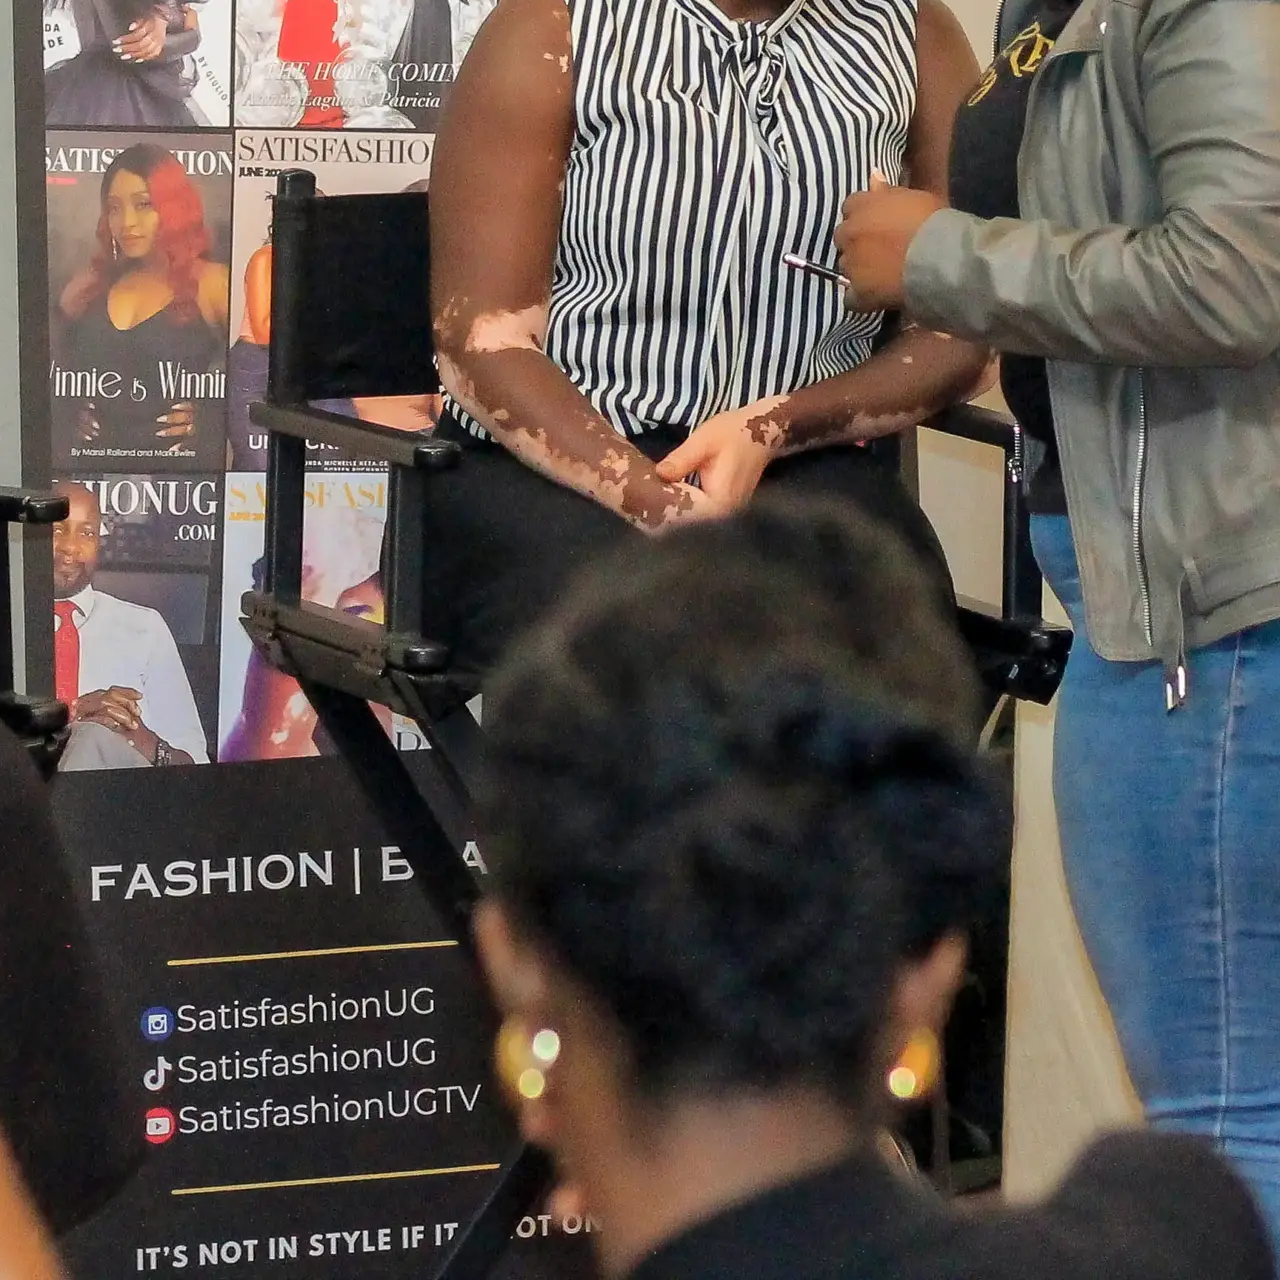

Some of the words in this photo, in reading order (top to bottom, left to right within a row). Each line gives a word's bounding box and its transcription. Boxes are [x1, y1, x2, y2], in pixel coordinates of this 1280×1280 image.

[379, 91, 441, 108] Patricia
[238, 135, 431, 165] SATISFASHIO
[239, 167, 263, 178] JUNE
[50, 360, 122, 399] innie
[174, 524, 216, 541] .COM
[90, 850, 333, 902] FASHION
[176, 987, 435, 1033] SatisfashionUG
[177, 1038, 437, 1084] SatisfashionUG
[178, 1084, 482, 1135] SatisfashionUGTV
[136, 1245, 189, 1271] IT'S
[199, 1239, 259, 1267] NOT
[268, 1236, 298, 1261] IN
[308, 1228, 391, 1257] STYLE
[402, 1225, 425, 1249] IF
[510, 1214, 552, 1239] OT
